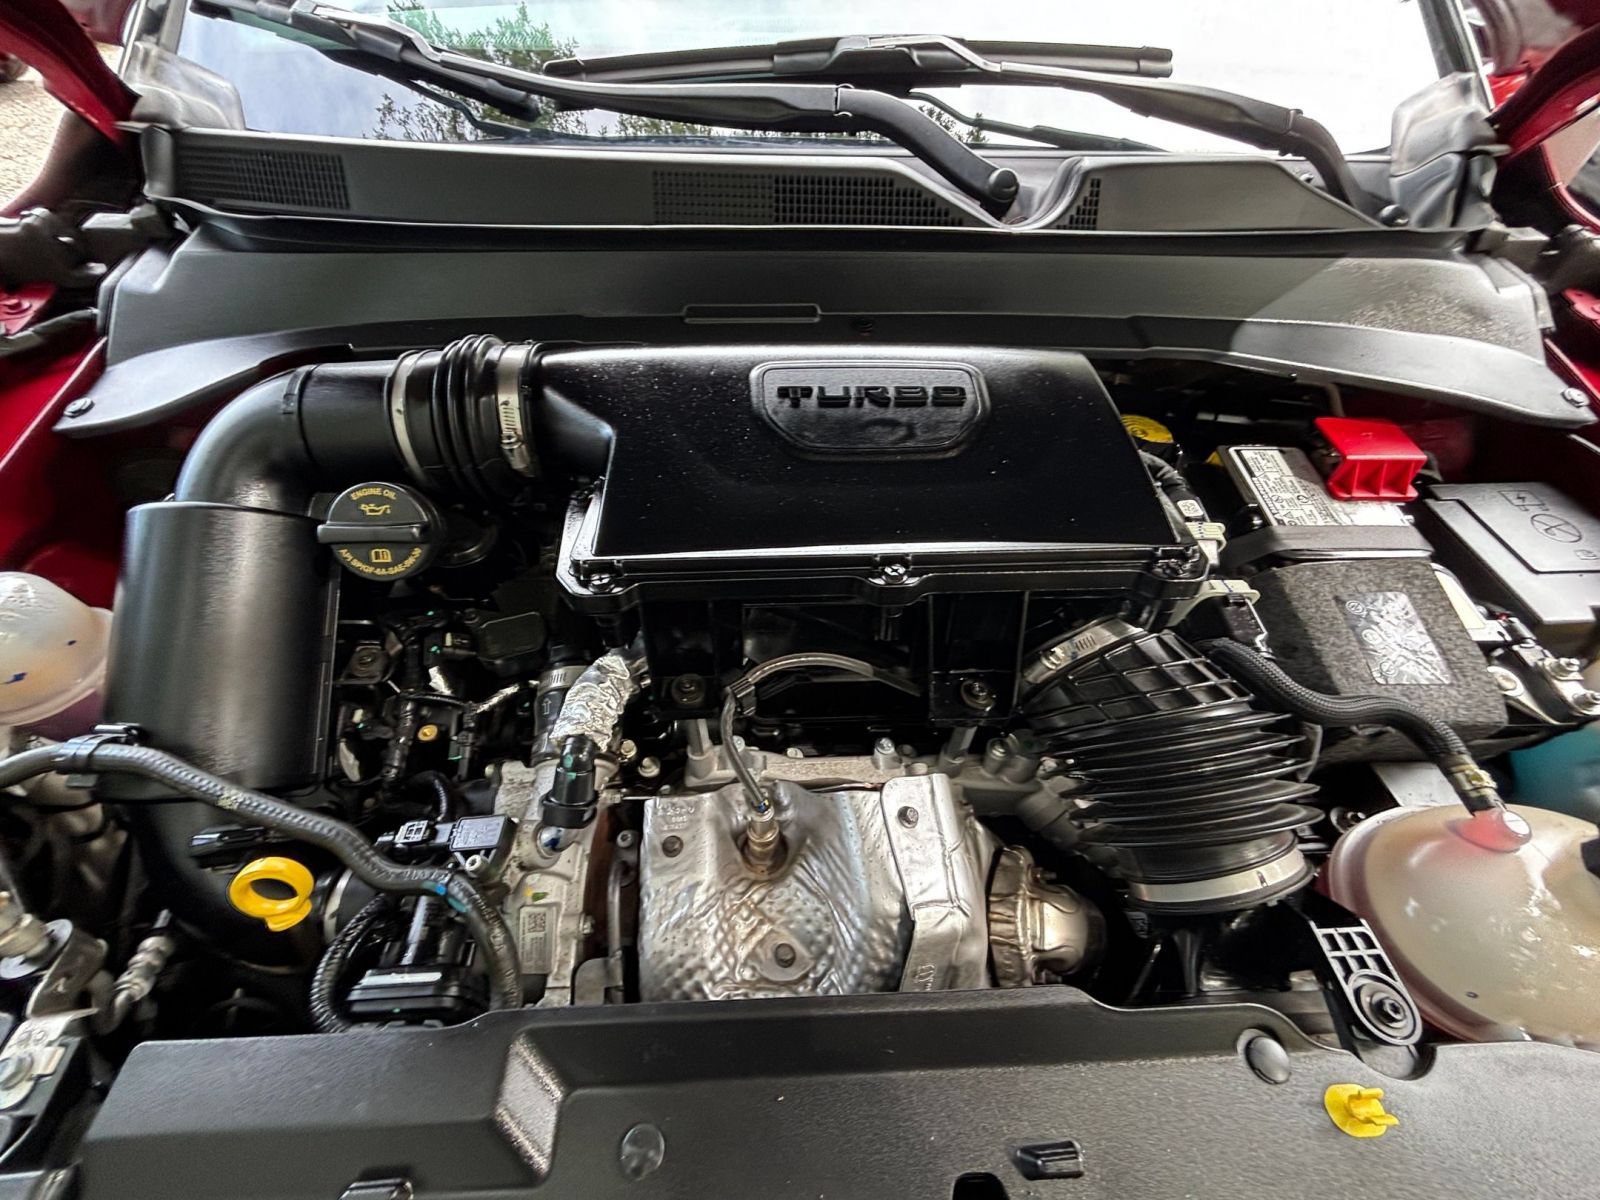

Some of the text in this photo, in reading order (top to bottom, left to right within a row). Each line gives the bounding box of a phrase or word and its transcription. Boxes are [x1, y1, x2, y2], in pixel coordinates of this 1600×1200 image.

[777, 386, 967, 409] TURBO
[350, 487, 397, 501] ENGINE OIL
[337, 548, 353, 562] API
